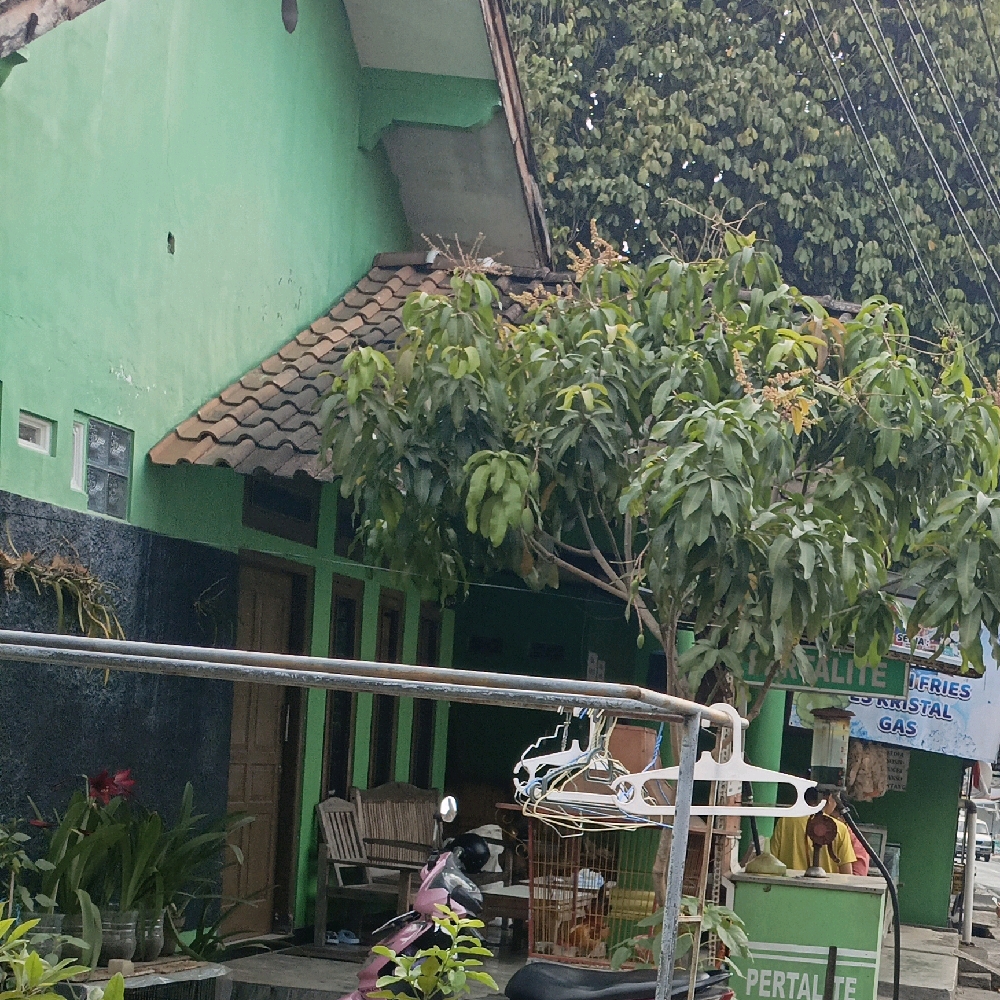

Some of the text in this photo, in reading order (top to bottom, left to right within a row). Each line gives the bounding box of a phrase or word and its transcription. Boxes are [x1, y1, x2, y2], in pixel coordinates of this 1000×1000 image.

[919, 676, 971, 699] FRIES
[877, 697, 952, 721] KRISTAL
[879, 715, 918, 736] GAS
